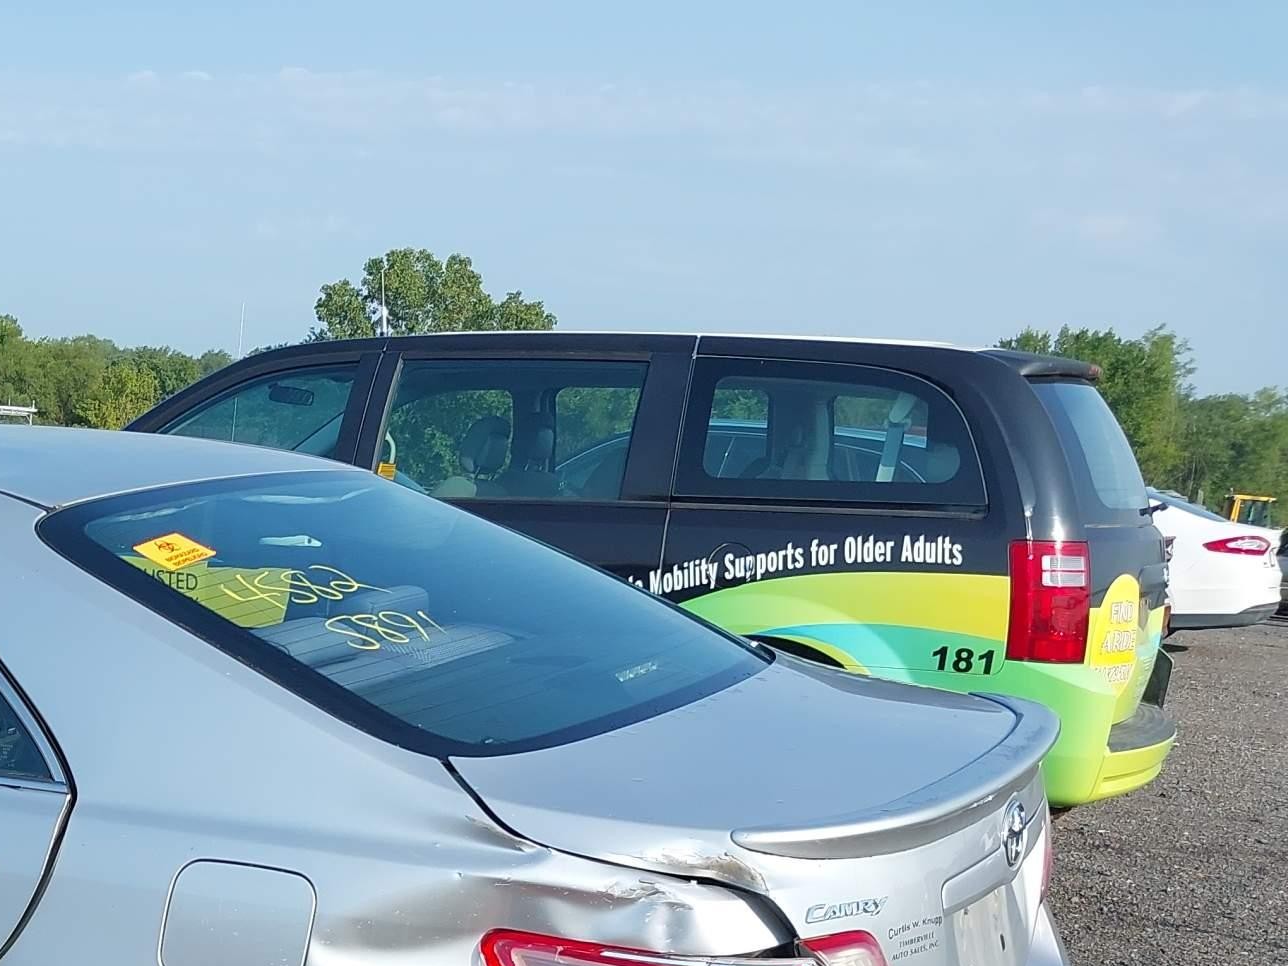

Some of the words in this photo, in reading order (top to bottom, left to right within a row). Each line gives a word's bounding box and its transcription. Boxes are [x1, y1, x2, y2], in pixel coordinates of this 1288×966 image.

[648, 557, 719, 595] Mobility
[724, 543, 805, 580] Supports
[810, 539, 838, 567] for
[844, 536, 895, 564] Older
[900, 534, 963, 566] Adults
[220, 565, 393, 609] 4582
[932, 645, 995, 675] 181
[805, 896, 889, 924] CAMRY
[888, 924, 911, 940] Curtis
[891, 951, 909, 961] AUTO
